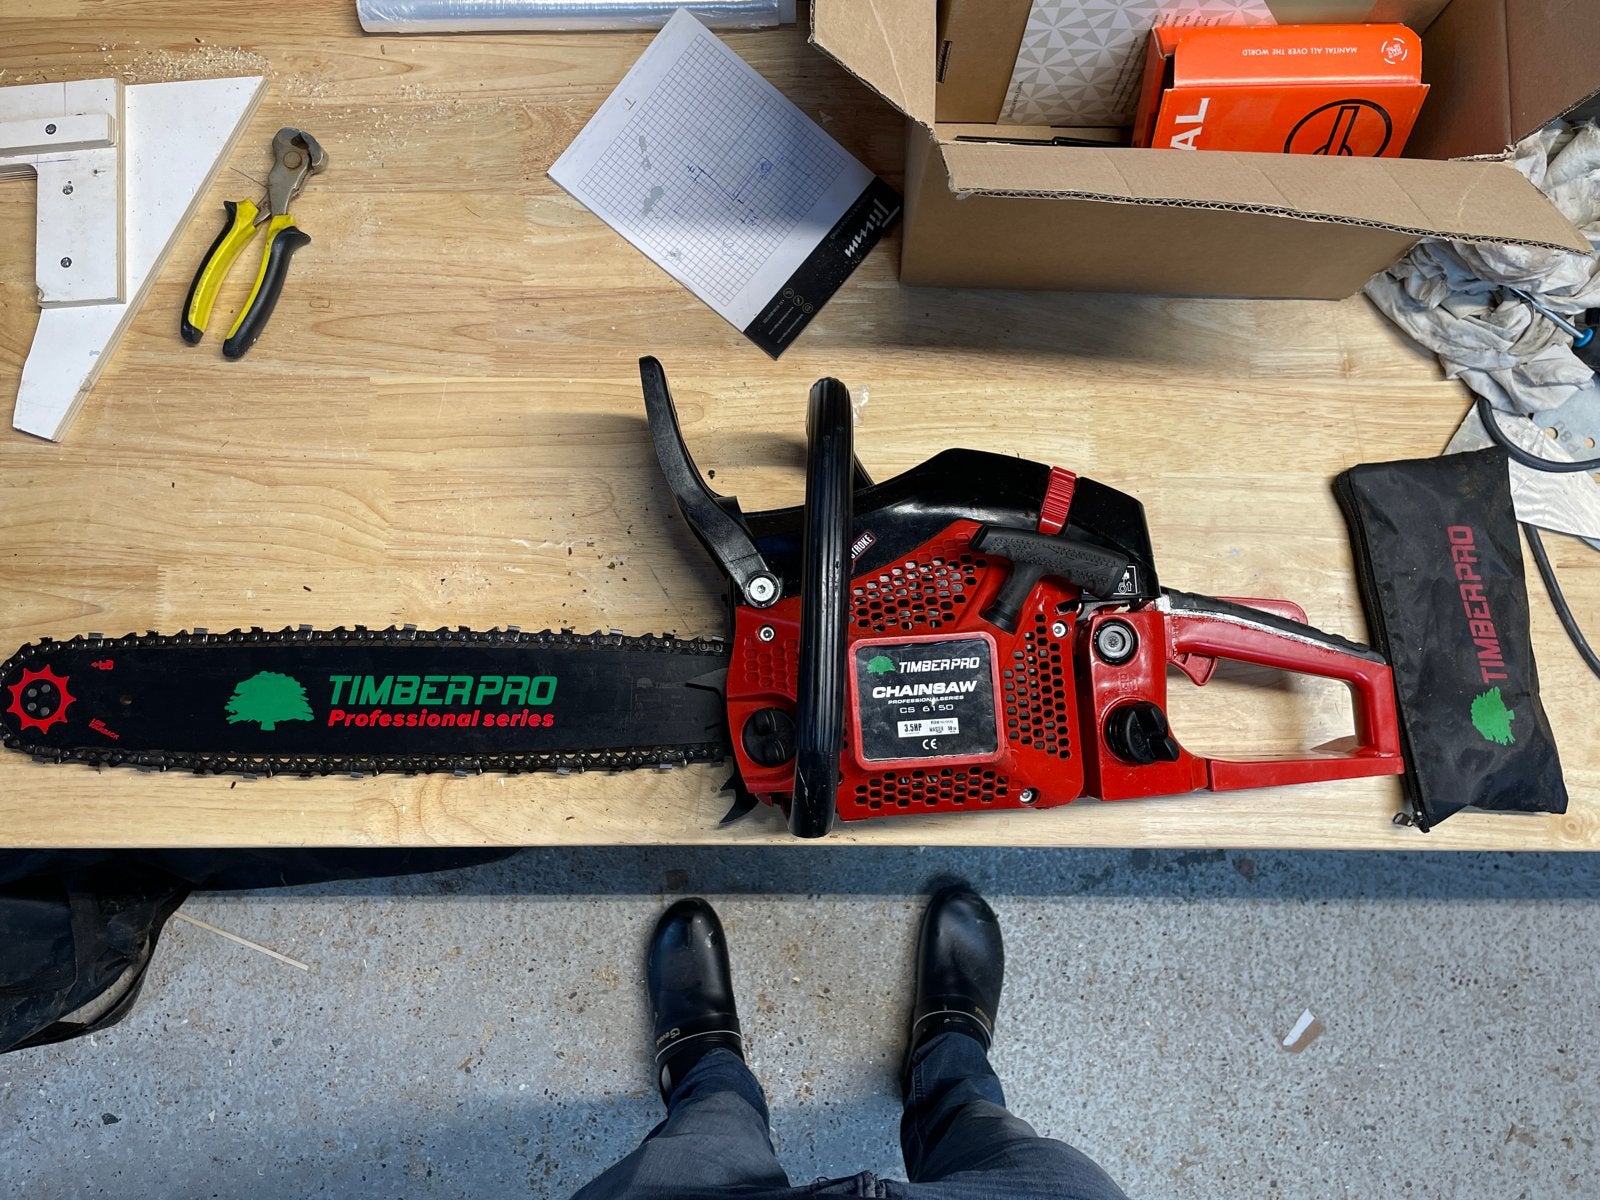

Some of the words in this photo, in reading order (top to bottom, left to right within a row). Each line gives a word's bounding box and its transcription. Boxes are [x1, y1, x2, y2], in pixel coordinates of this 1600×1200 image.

[1446, 525, 1508, 684] TIMBERPRO
[899, 657, 980, 674] TIMBERPRO
[329, 675, 558, 705] TIMBERPRO
[872, 680, 977, 699] CHAINSAW
[328, 708, 480, 727] Professional
[482, 708, 555, 727] series
[900, 706, 915, 714] CS
[922, 704, 954, 712] 6150
[922, 738, 937, 750] CE
